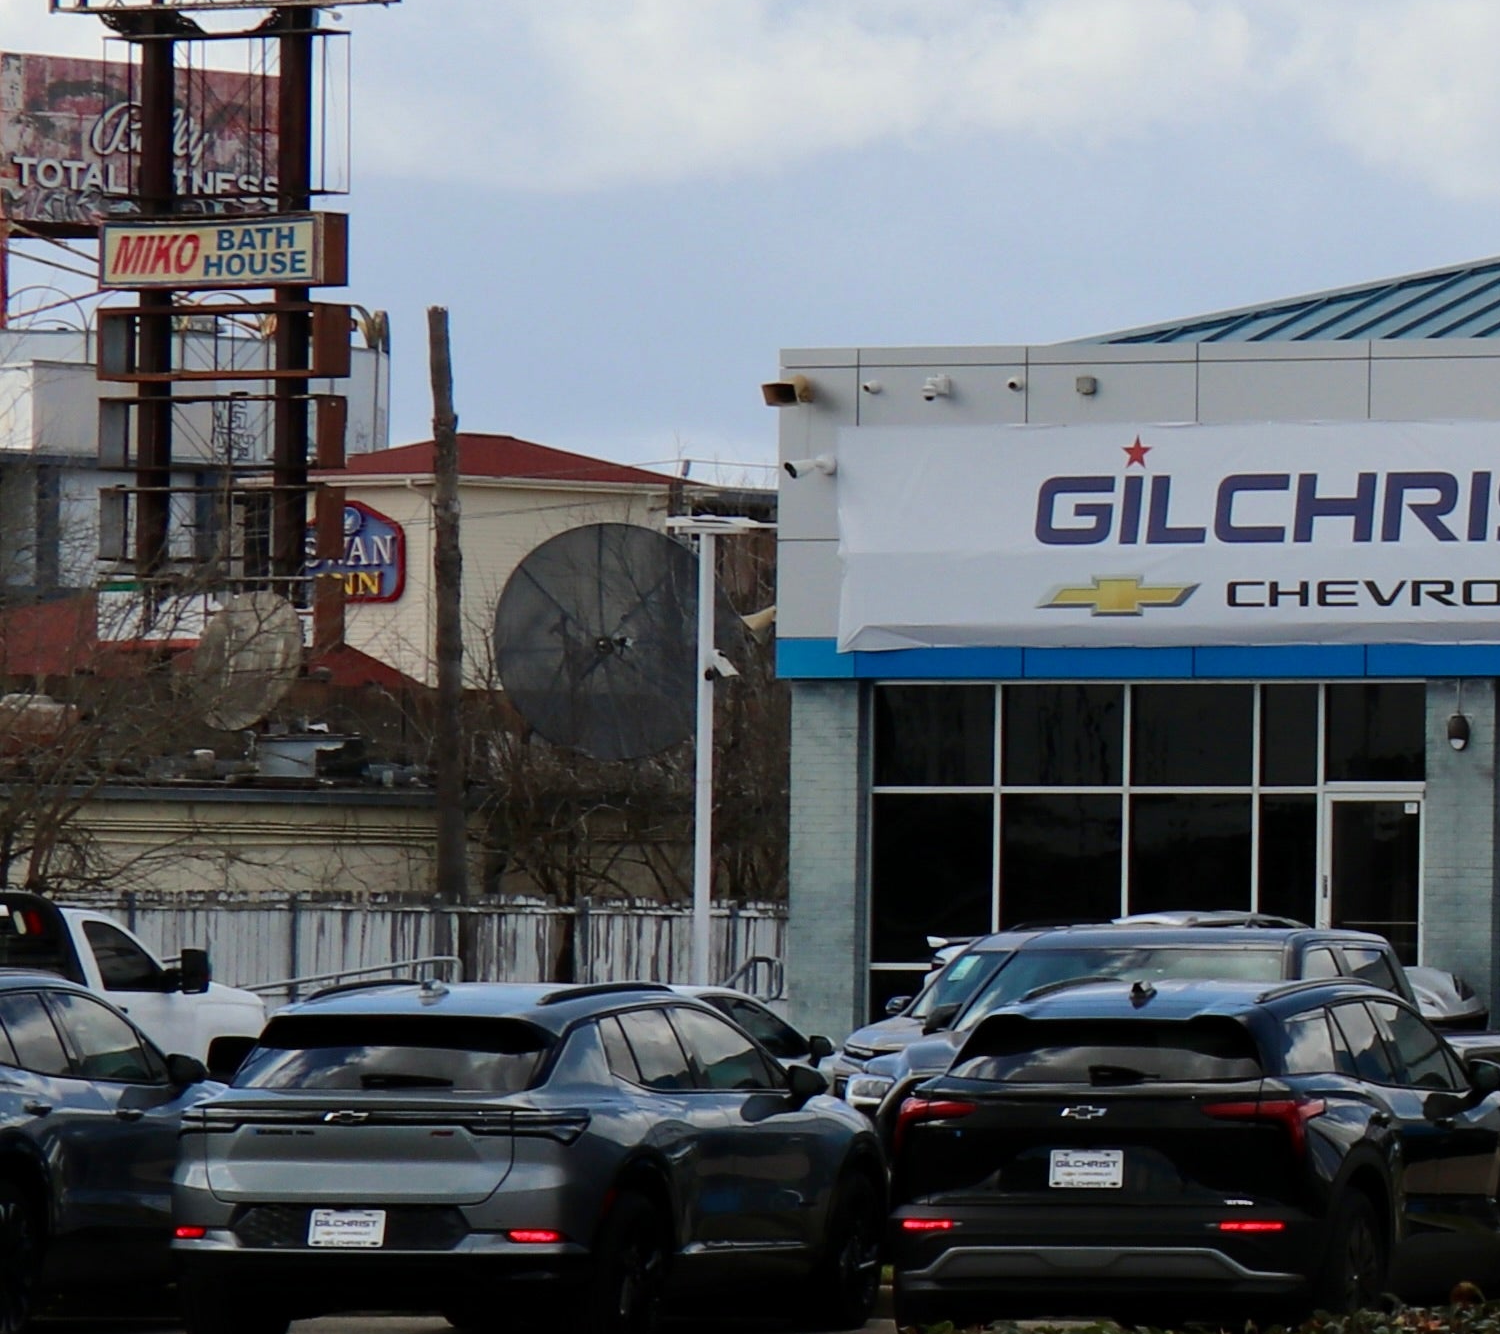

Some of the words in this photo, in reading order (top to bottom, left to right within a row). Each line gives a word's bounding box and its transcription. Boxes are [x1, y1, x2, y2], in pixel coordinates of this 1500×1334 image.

[13, 156, 130, 195] TOTAL
[111, 233, 200, 276] MIKO
[216, 225, 295, 252] BATH
[202, 249, 307, 278] HOUSE
[304, 534, 393, 567] SAN
[315, 571, 380, 596] NN
[1056, 1160, 1118, 1168] GILCHRIST
[315, 1219, 377, 1227] GILCHRIST
